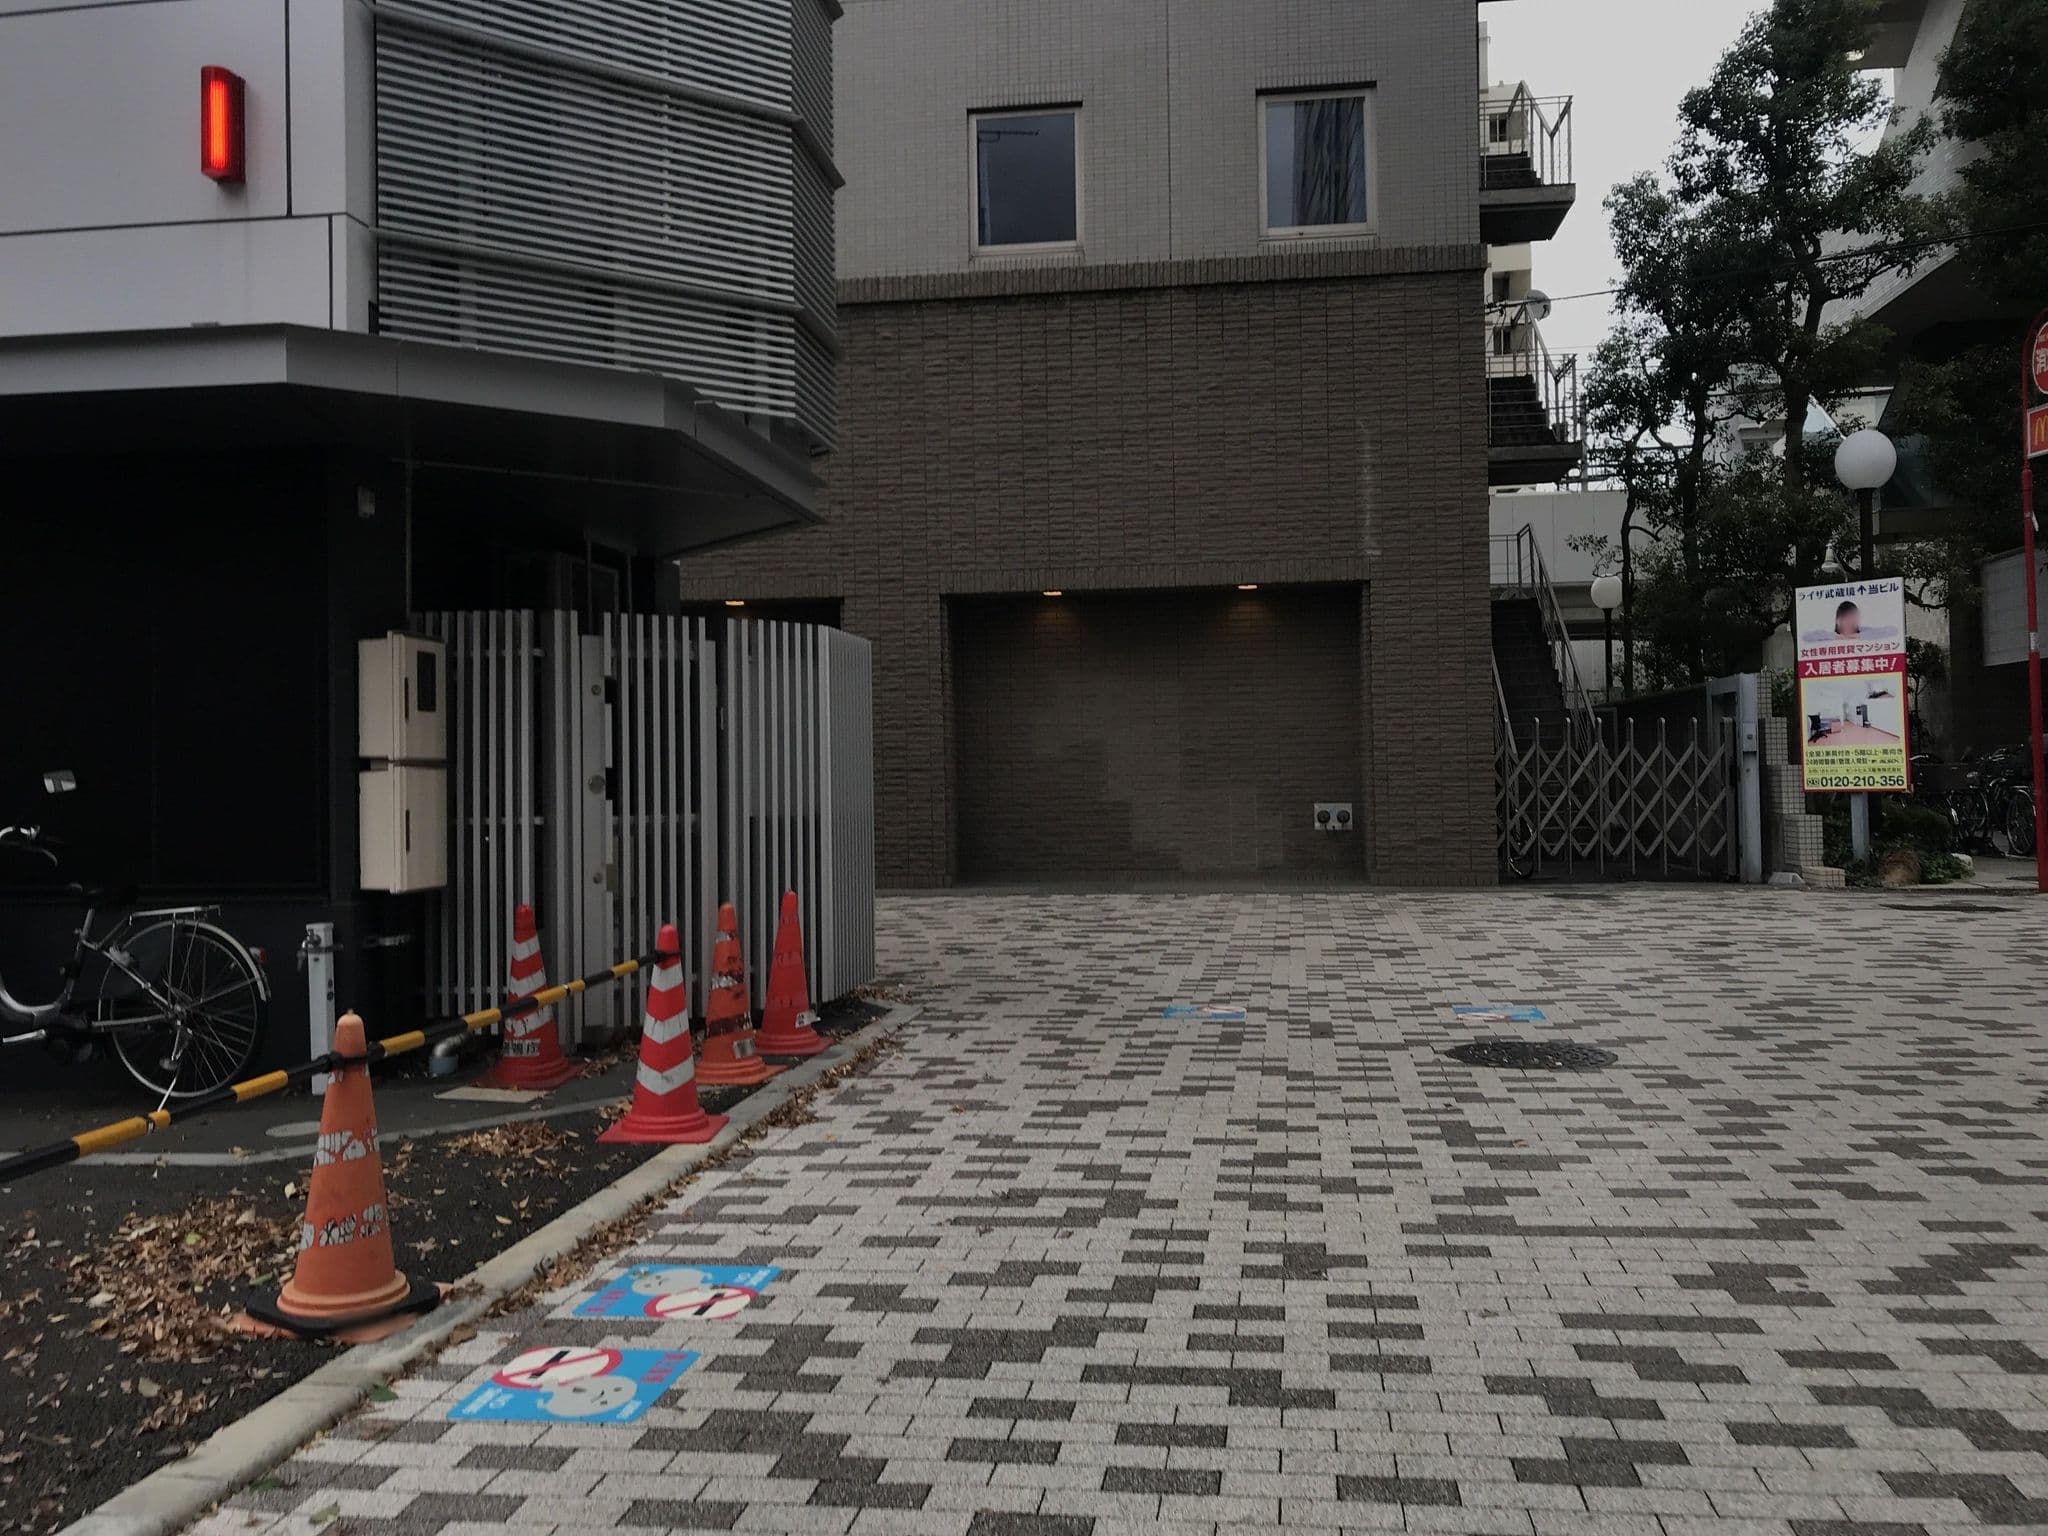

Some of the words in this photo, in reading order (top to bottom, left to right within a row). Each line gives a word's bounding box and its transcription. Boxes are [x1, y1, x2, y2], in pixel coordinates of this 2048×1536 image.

[1868, 582, 1900, 595] 当ビル
[1820, 775, 1906, 788] 0120-210-356
